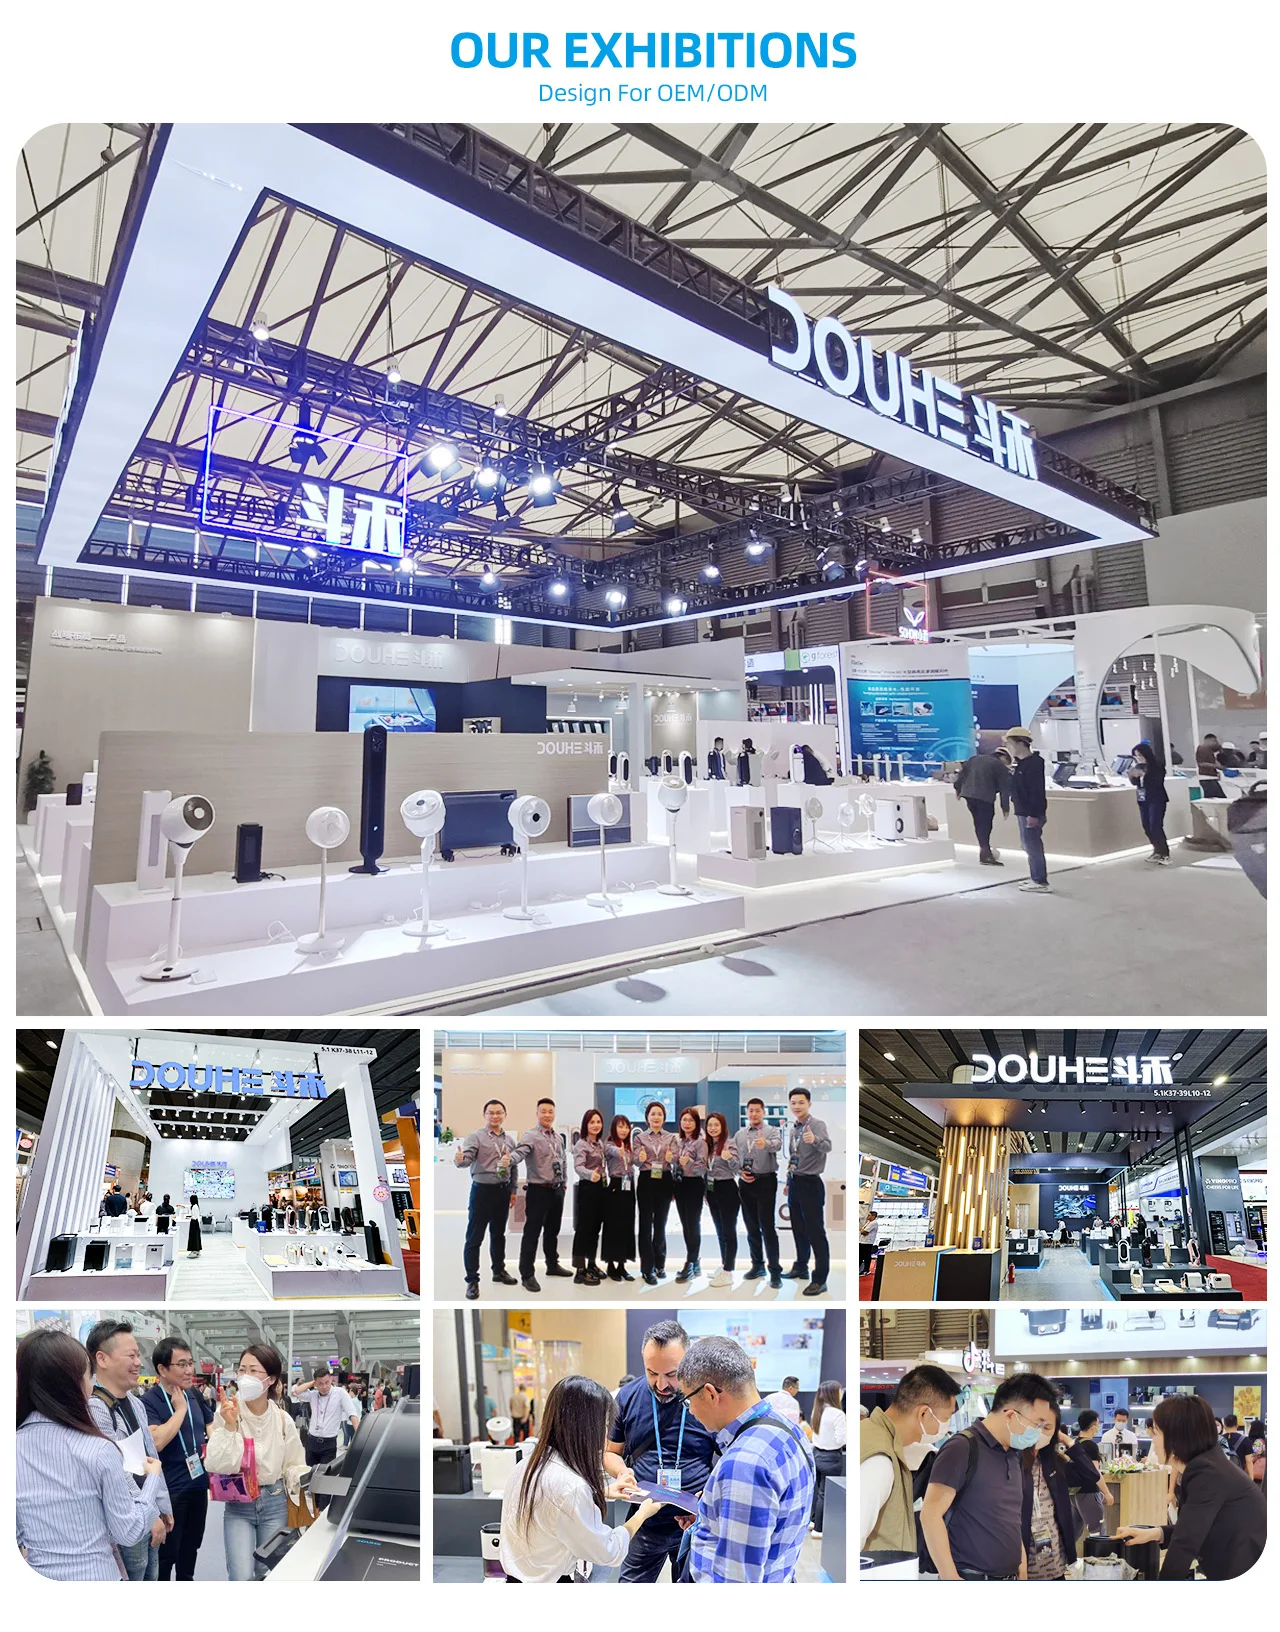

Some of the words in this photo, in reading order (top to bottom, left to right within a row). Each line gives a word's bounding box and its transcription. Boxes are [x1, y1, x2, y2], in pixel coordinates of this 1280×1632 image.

[767, 285, 969, 449] DOUHE
[970, 393, 1039, 481] 斗禾
[295, 482, 407, 557] 斗禾
[335, 643, 409, 667] DOUHE
[537, 741, 583, 755] DOUHE
[130, 1059, 264, 1095] DOUHE
[270, 1070, 329, 1100] 斗禾
[970, 1053, 1109, 1084] DOUHE
[1111, 1055, 1174, 1085] 斗禾
[1153, 1089, 1212, 1097] 5.1K37-39L10-12
[378, 1557, 420, 1567] PRODUCT
